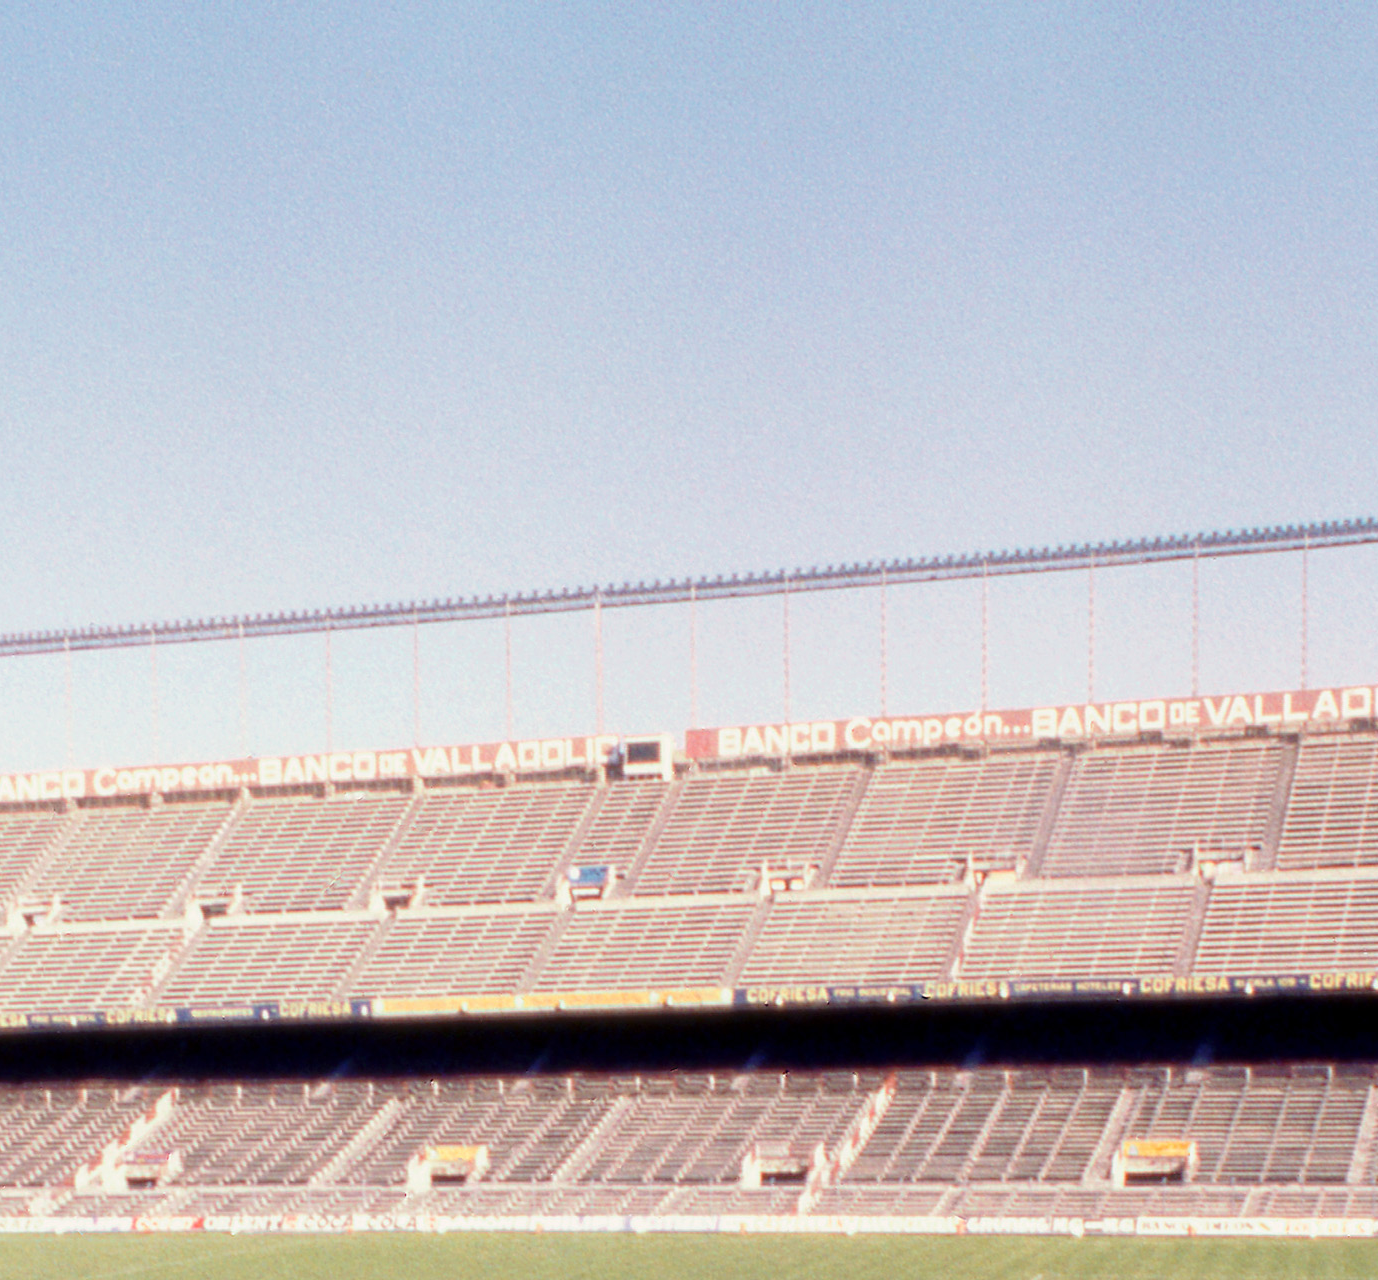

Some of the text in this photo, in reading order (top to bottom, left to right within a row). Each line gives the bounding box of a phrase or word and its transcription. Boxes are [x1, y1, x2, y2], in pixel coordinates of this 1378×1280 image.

[718, 720, 836, 756] BANCO
[1031, 700, 1166, 738] BANCO
[1169, 700, 1201, 726] DE
[258, 751, 376, 784] BANCO
[379, 752, 408, 775] DE
[411, 735, 619, 777] VALLADOLID
[1139, 976, 1230, 993] COFRIESA
